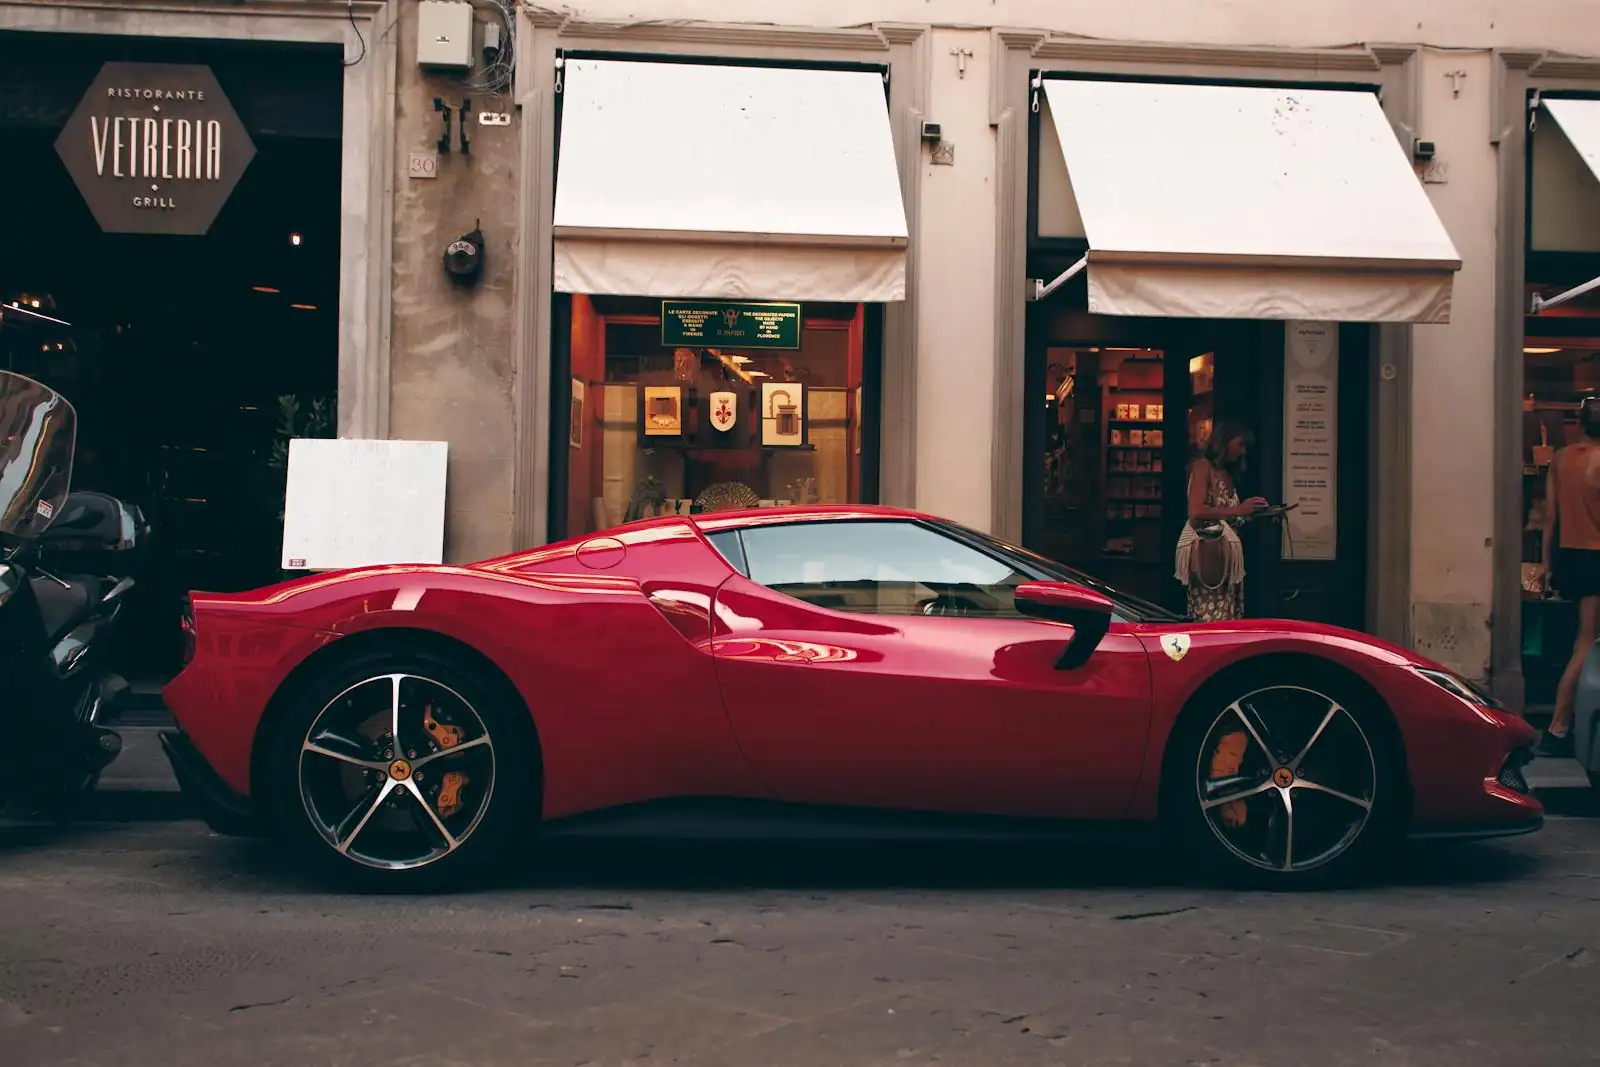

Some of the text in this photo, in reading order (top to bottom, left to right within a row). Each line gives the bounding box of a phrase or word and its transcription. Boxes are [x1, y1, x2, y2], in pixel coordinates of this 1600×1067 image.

[108, 87, 205, 101] RISTORANTE
[90, 116, 221, 180] VETRERIA
[412, 158, 434, 173] 30
[133, 197, 176, 209] GRILL
